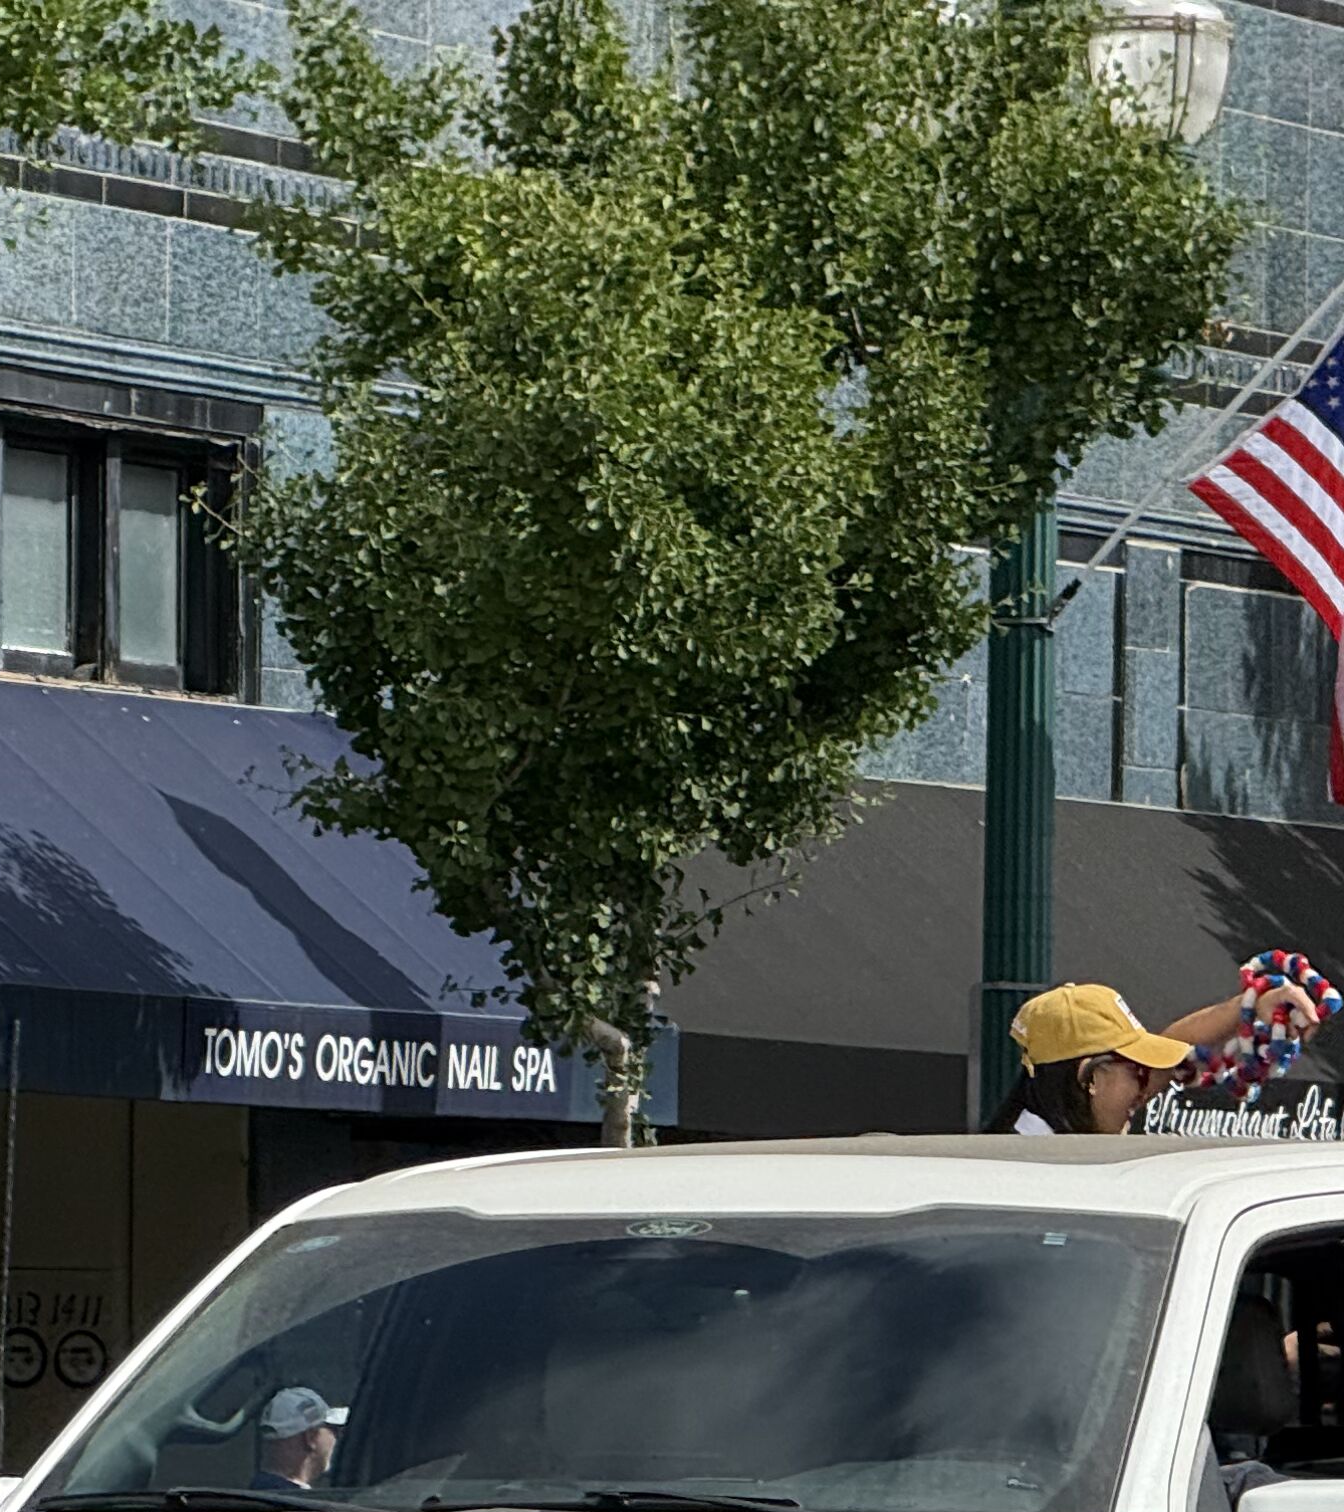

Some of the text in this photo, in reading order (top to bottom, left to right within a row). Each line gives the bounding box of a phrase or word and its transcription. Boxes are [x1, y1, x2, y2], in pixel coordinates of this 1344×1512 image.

[204, 1028, 555, 1093] TOMO'S ORGANIC NAIL SPA
